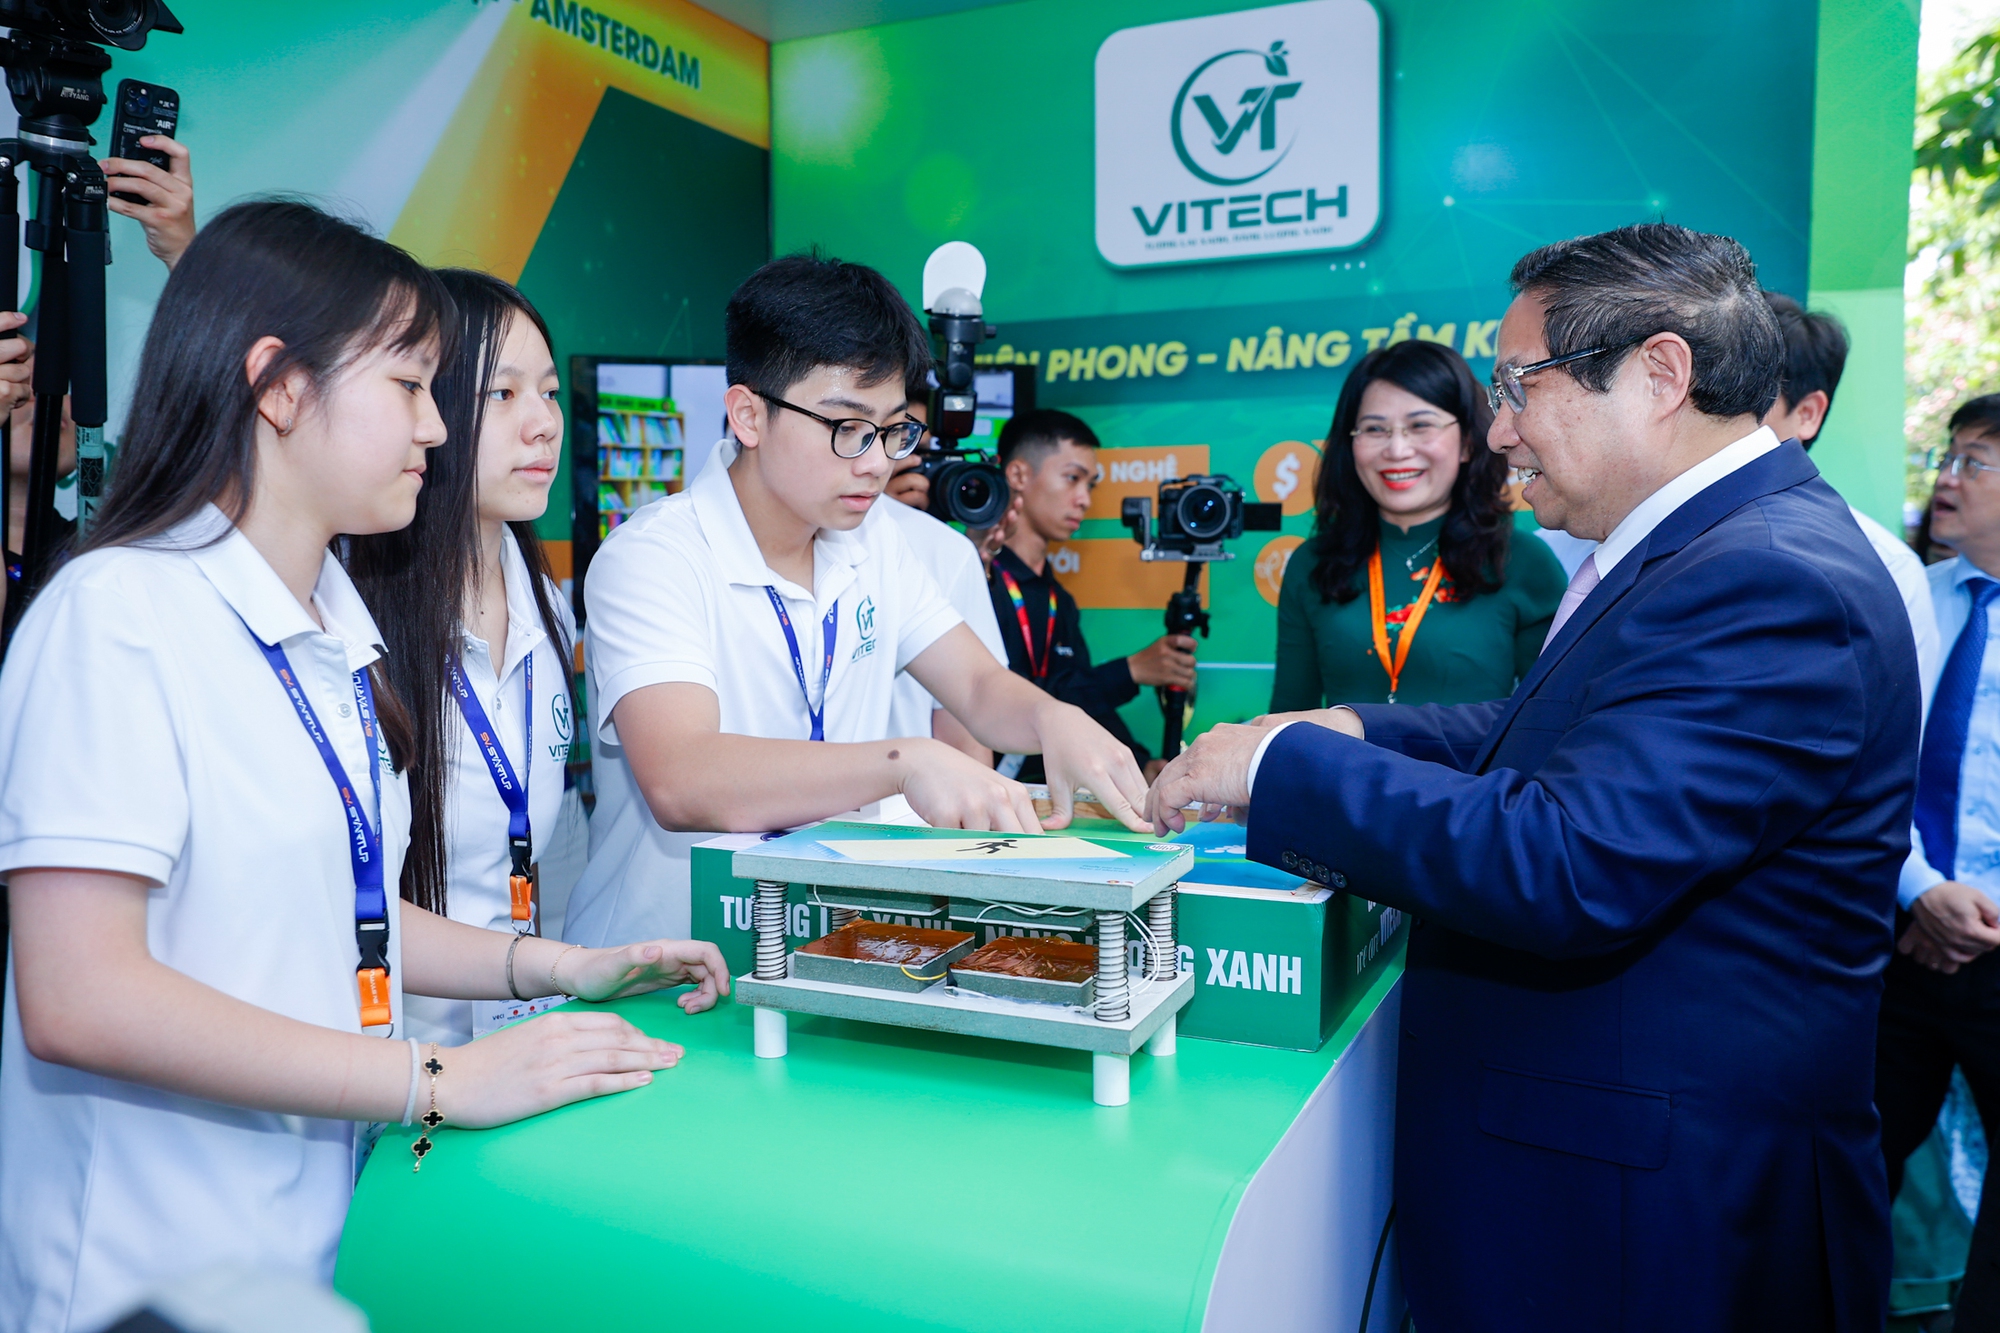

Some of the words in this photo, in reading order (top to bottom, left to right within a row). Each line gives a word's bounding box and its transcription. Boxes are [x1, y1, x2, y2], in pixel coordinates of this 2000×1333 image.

[530, 0, 700, 89] AMSTERDAM
[1192, 81, 1303, 155] VT
[1132, 185, 1348, 236] VITECH
[1045, 341, 1188, 383] PHONG
[1226, 328, 1352, 373] NÂNG
[1205, 947, 1302, 995] XANH
